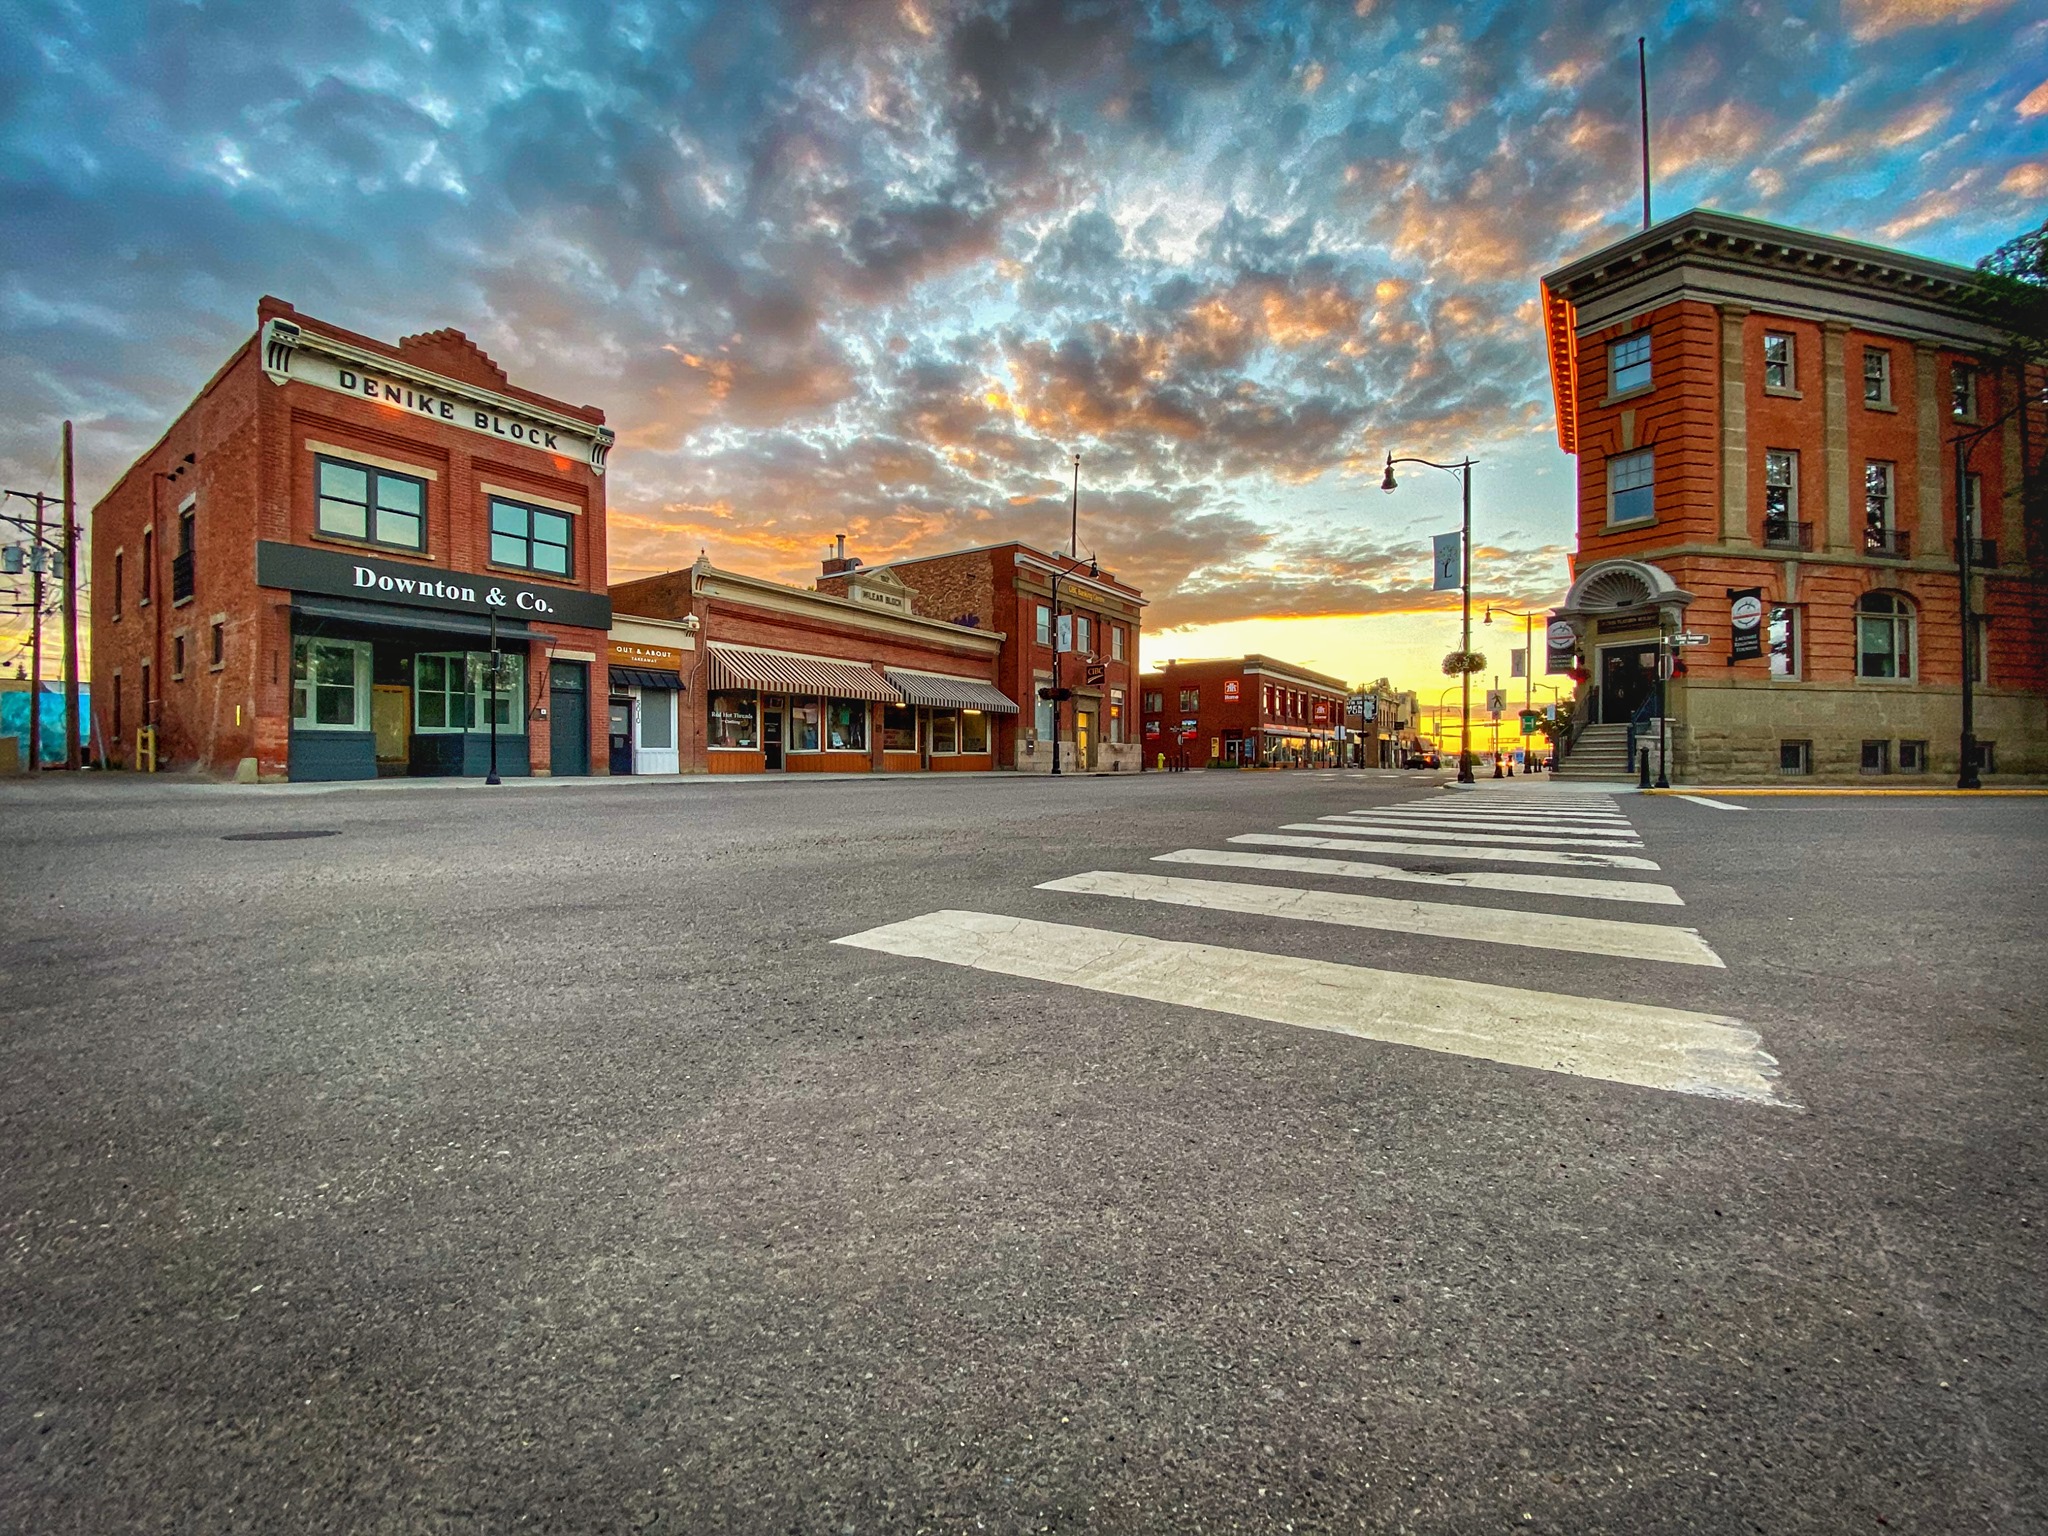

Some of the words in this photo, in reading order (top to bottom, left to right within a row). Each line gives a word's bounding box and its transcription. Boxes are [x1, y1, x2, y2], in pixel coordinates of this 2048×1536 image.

[339, 370, 454, 420] DENIKE
[474, 411, 558, 450] BLOCK
[353, 566, 476, 603] Downton
[485, 587, 507, 607] &
[516, 591, 554, 613] Co.
[645, 649, 672, 658] ABOUT
